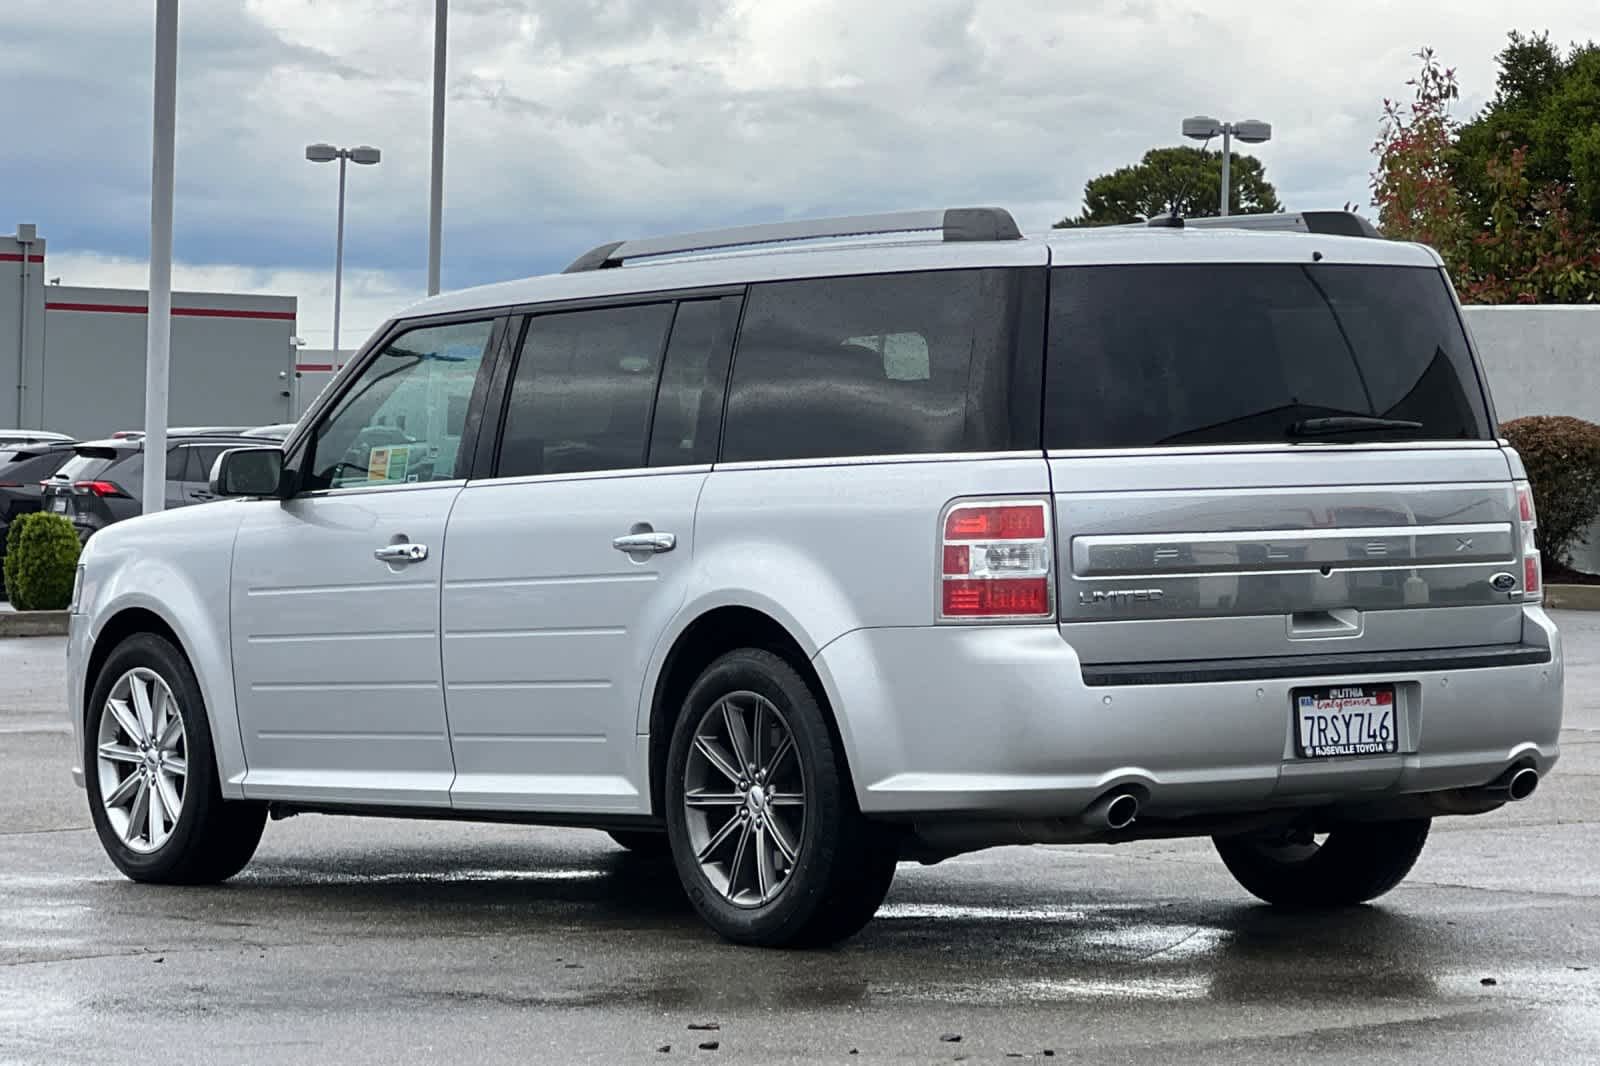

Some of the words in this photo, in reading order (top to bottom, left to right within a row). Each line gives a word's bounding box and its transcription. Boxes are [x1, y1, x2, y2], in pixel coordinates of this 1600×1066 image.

[1079, 588, 1164, 607] LIMITED
[1317, 699, 1374, 713] California
[1304, 711, 1390, 746] 7RSY746
[1316, 745, 1355, 755] ROSEVILLE
[1356, 743, 1384, 753] TOYOTA
